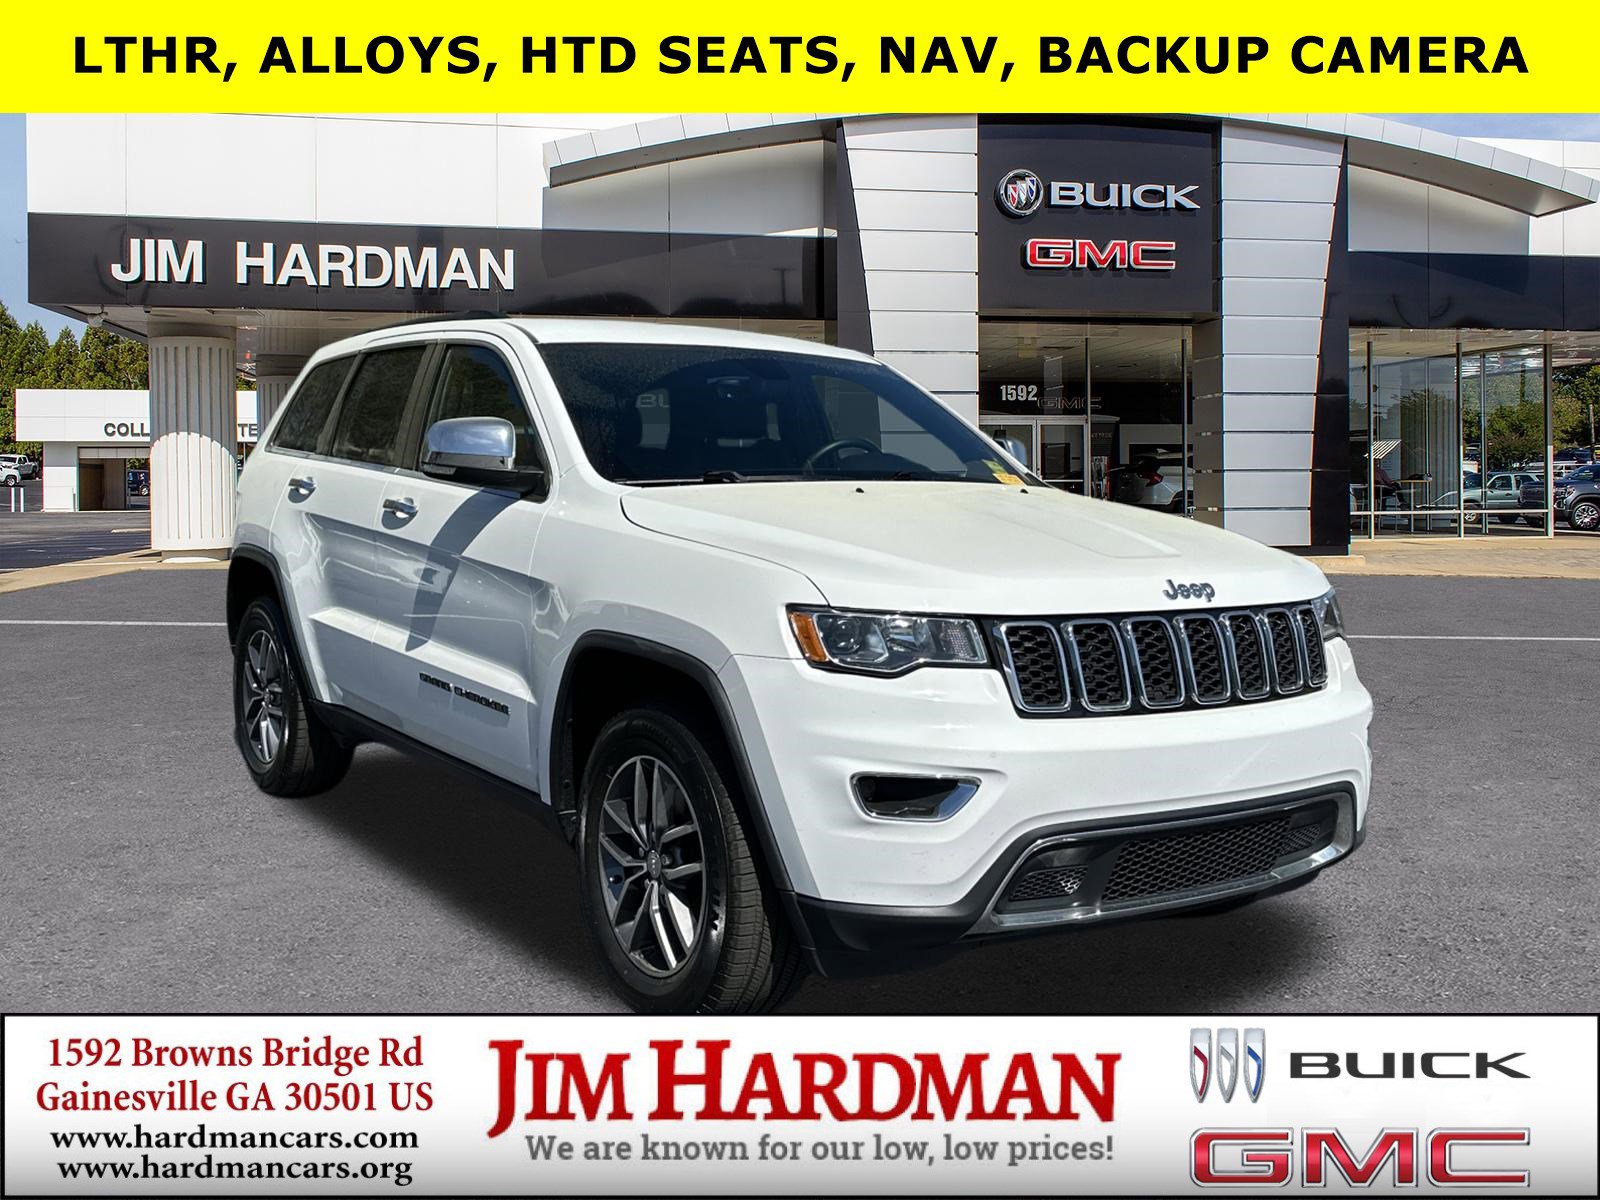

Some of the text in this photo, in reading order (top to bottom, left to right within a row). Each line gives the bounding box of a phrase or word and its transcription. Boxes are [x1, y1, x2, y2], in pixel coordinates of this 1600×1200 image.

[1051, 181, 1200, 209] BUICK
[111, 238, 515, 291] JIM HARDMAN
[1026, 238, 1176, 270] GMC
[1000, 384, 1037, 401] 1592
[1162, 579, 1216, 603] Jeep
